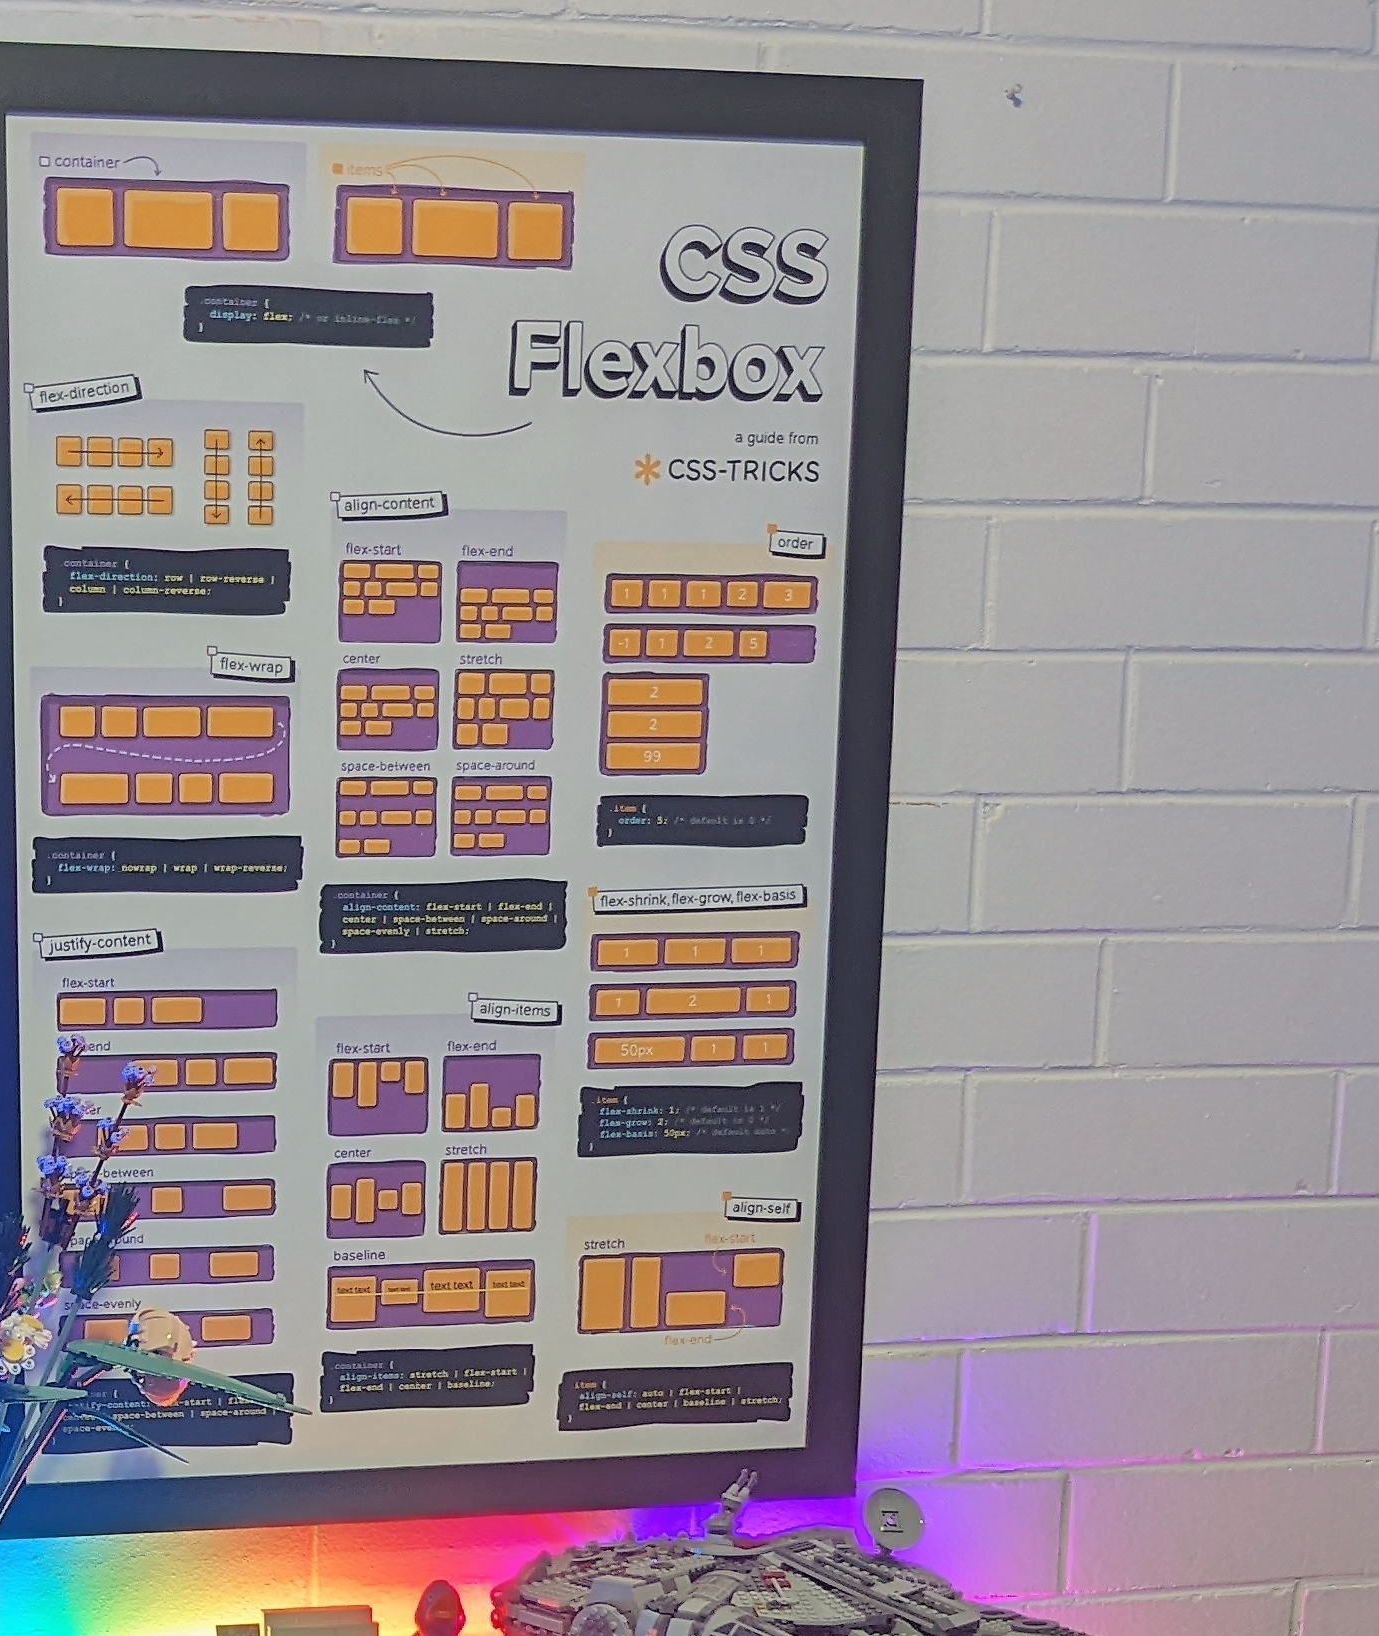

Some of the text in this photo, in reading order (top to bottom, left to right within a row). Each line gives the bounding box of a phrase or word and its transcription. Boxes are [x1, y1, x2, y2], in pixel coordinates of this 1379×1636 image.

[54, 154, 383, 177] container items
[659, 224, 829, 305] CSS
[210, 310, 257, 323] display:
[509, 320, 825, 402] Flexbox
[39, 381, 130, 404] flex-direction
[735, 431, 819, 446] a guide from
[668, 459, 820, 482] CSS-TRICKS
[344, 498, 435, 514] align-content
[346, 543, 514, 557] flex-start flex-end
[778, 537, 813, 550] order
[220, 658, 283, 675] flex-wrap
[343, 654, 502, 665] center stretch
[643, 751, 661, 762] 99
[341, 760, 535, 772] space-between space-around
[600, 889, 796, 908] flex-shrink, flex-grow, flex-basis
[48, 931, 152, 955] justify-content
[62, 977, 115, 988] flex-start
[480, 1003, 551, 1018] align-items
[336, 1040, 497, 1054] flex-start flex-end
[621, 1044, 653, 1057] 50px
[334, 1144, 487, 1159] center stretch
[733, 1202, 791, 1216] align-self
[584, 1238, 625, 1250] stretch
[333, 1249, 386, 1261] baseline
[64, 1298, 141, 1311] sace-evenly
